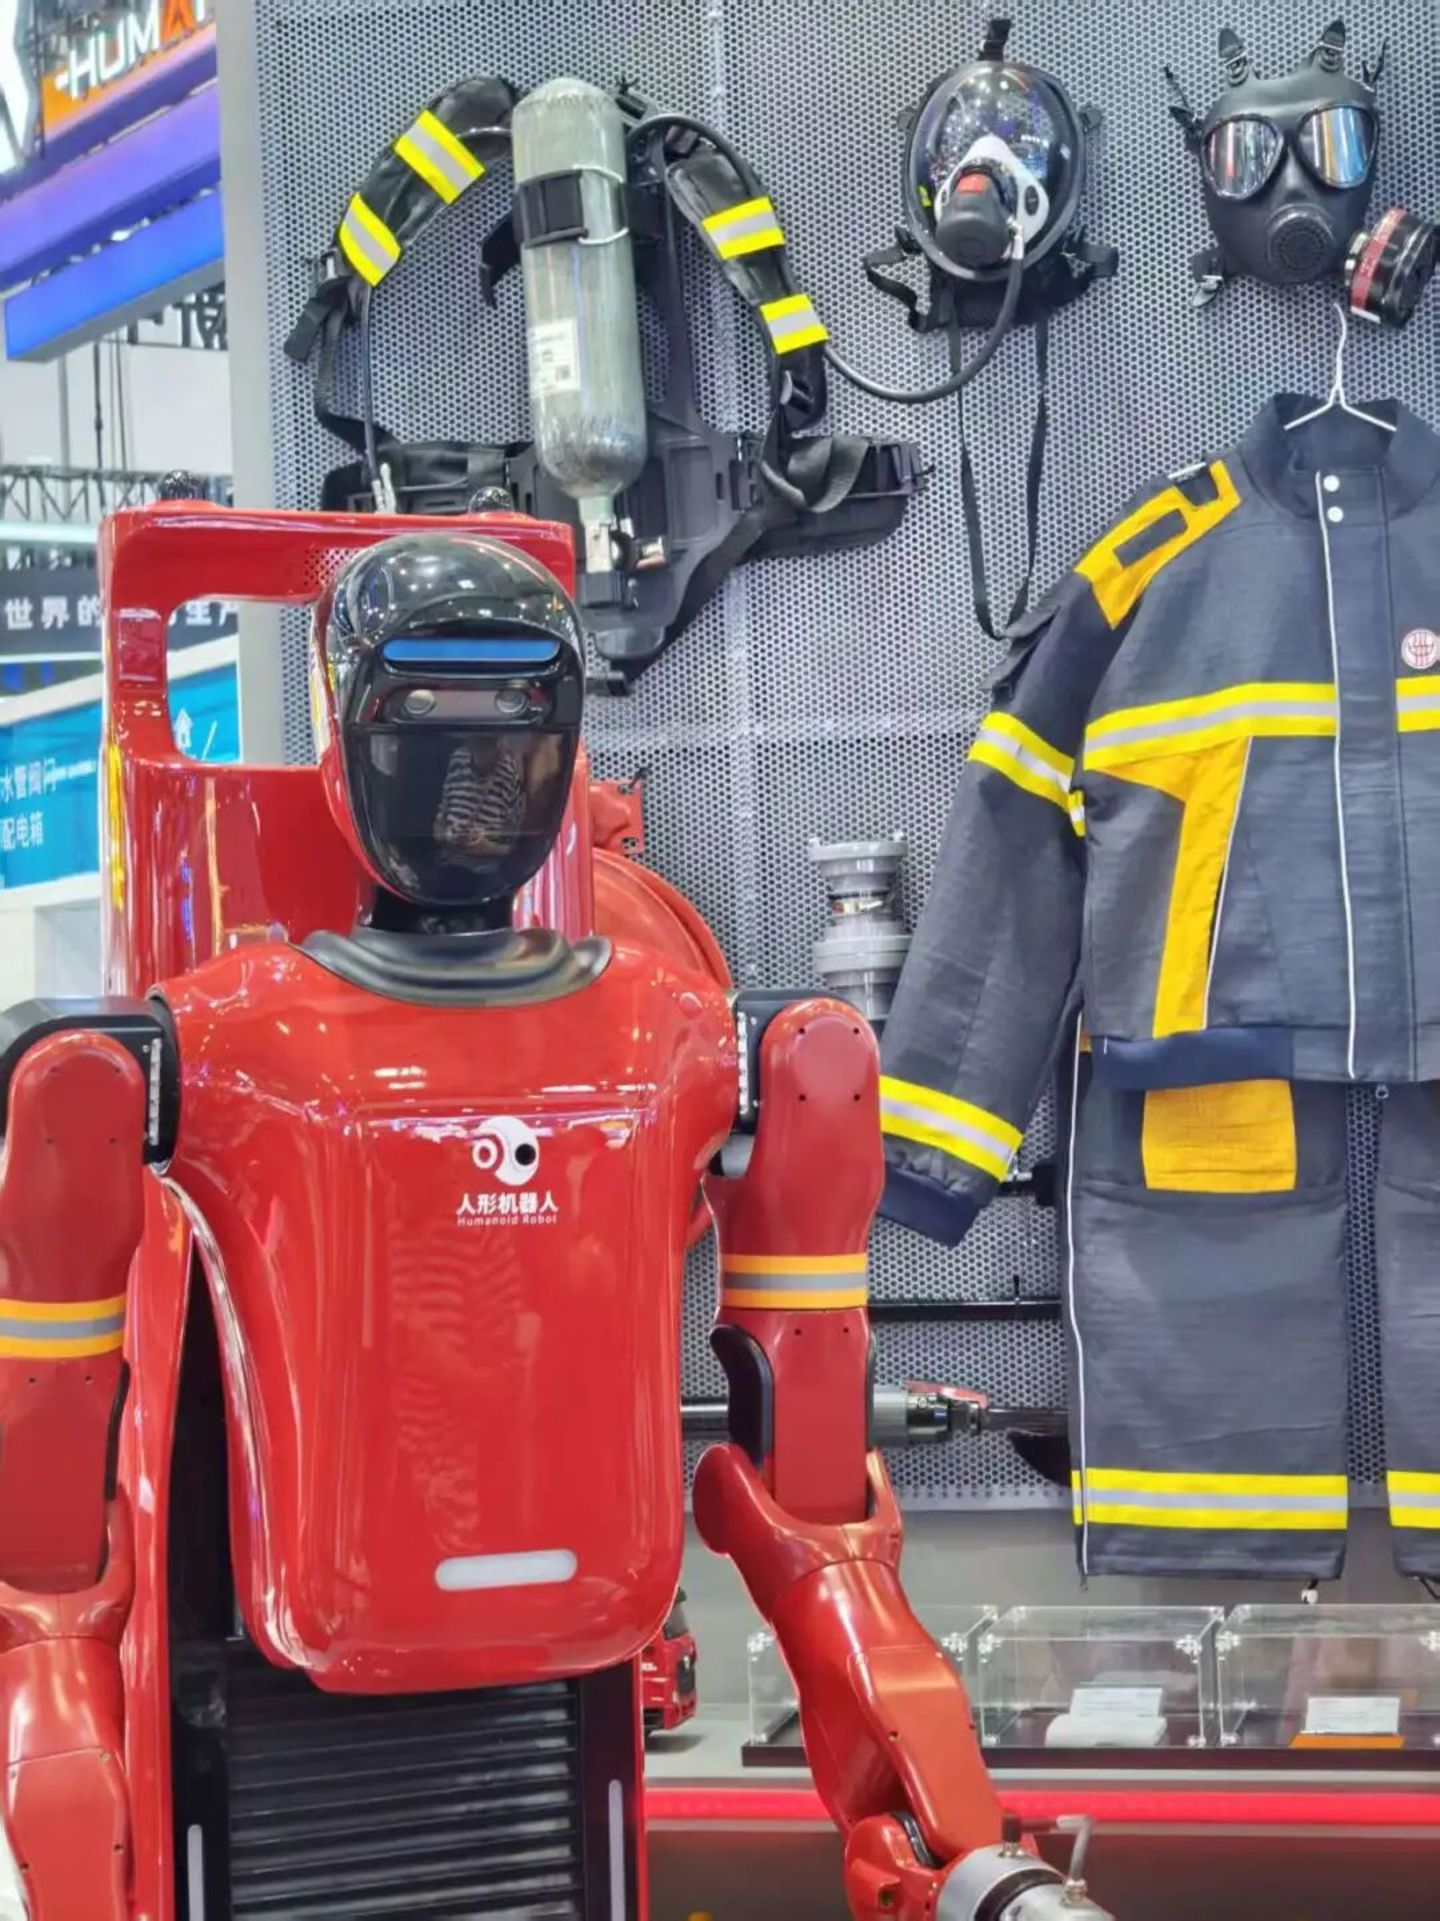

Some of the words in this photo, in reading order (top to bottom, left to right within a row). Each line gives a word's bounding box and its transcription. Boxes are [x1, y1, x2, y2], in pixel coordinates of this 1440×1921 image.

[456, 1190, 559, 1215] 人形机器人
[457, 1214, 518, 1227] Humanoid
[522, 1213, 558, 1226] Robot
